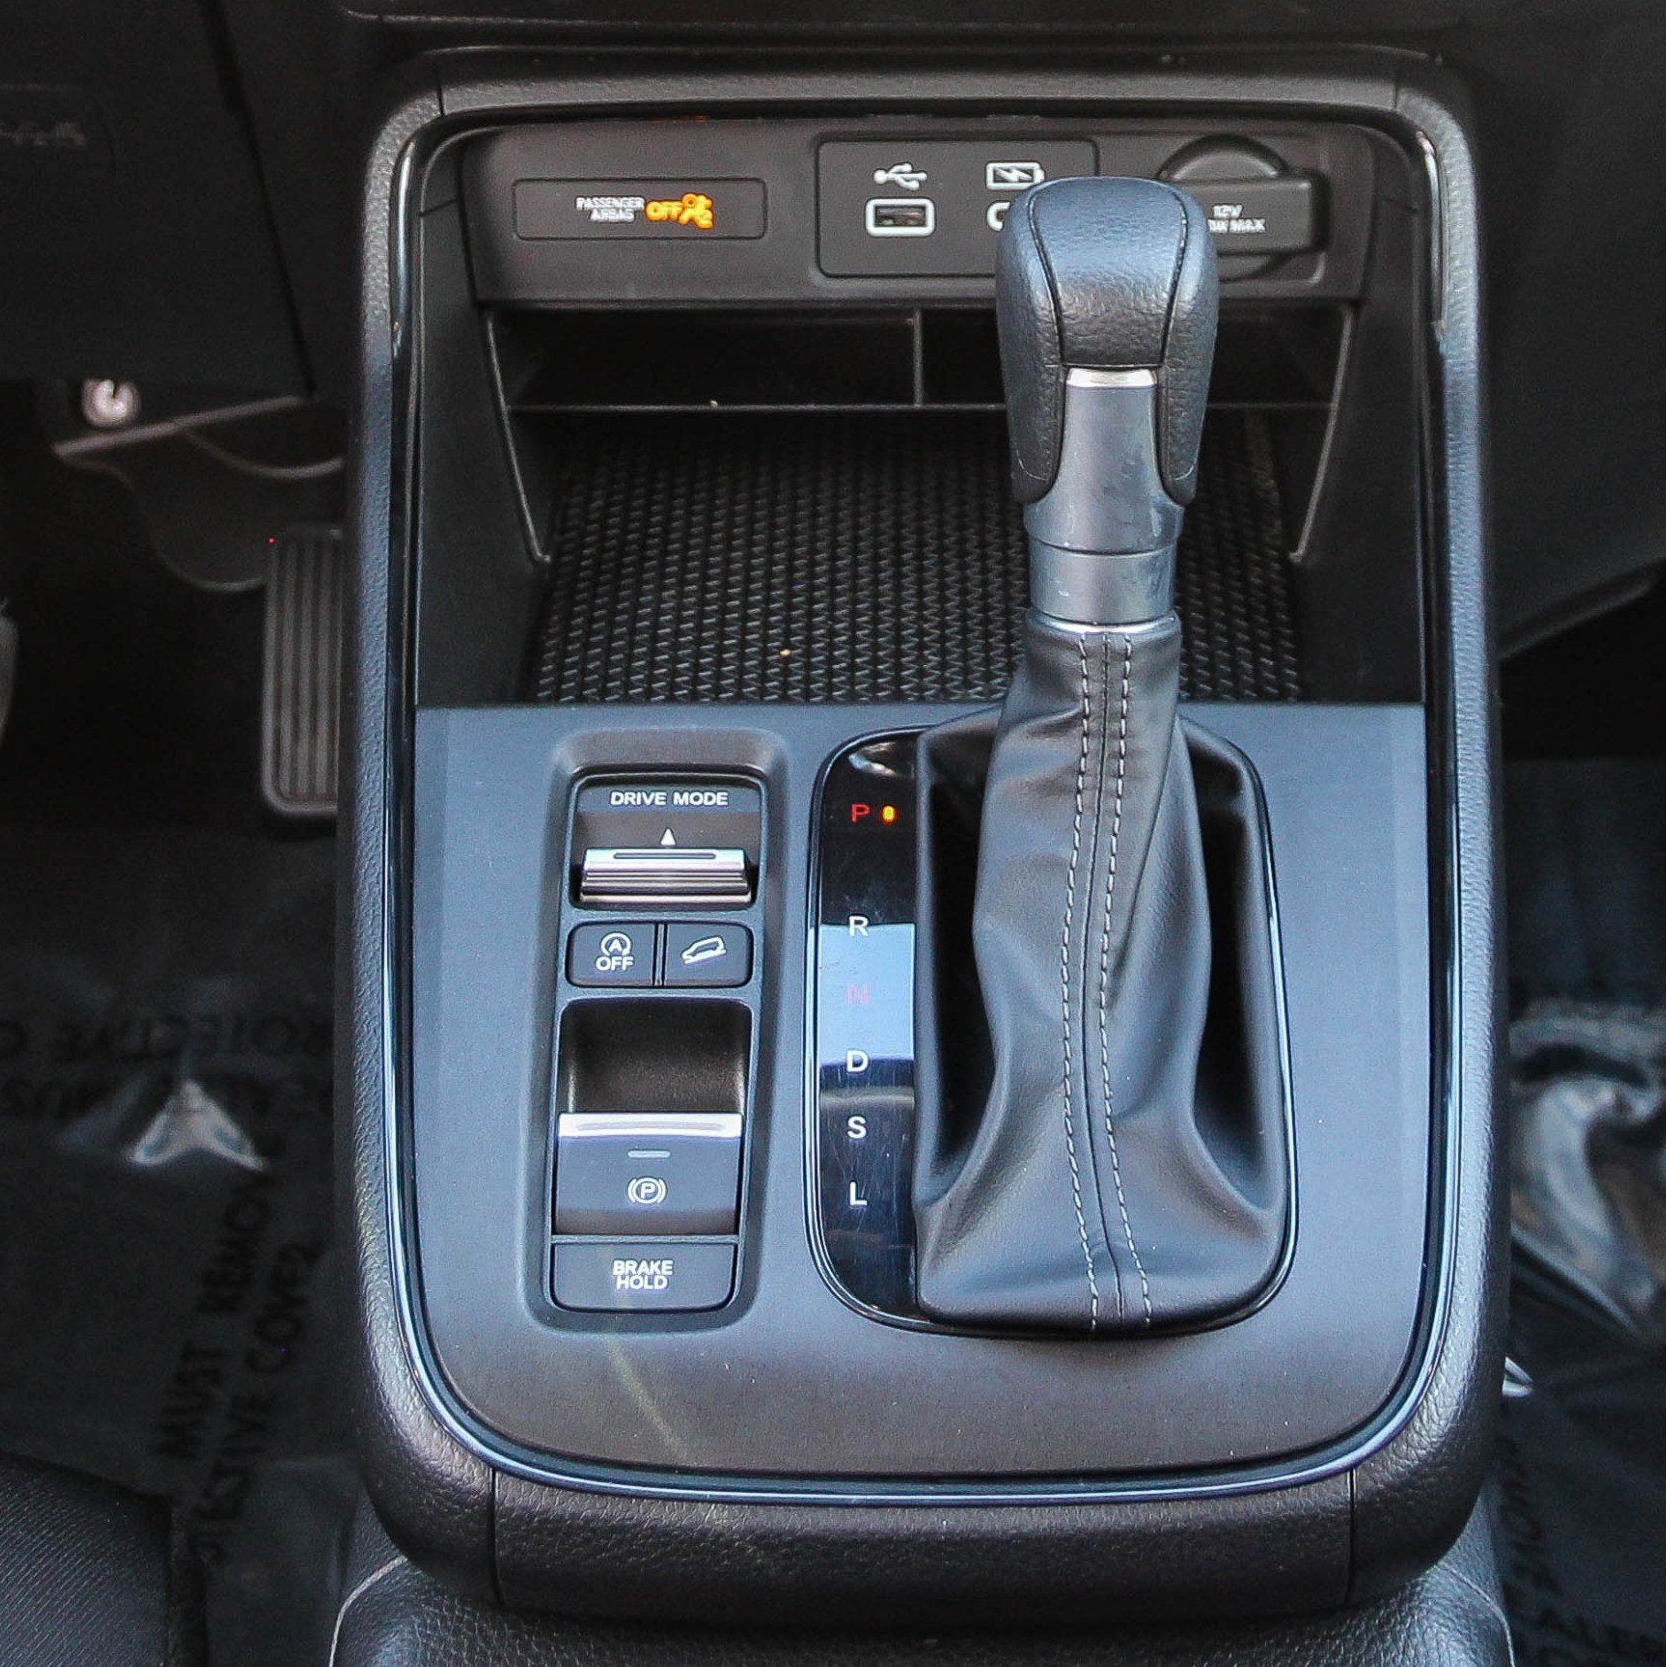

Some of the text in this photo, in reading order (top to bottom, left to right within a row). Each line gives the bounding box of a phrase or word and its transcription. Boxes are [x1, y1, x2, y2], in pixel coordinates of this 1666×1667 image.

[576, 196, 645, 210] PASSENGER
[645, 200, 683, 222] OFF
[610, 791, 728, 806] DRIVE MODE
[851, 804, 870, 822] P
[848, 916, 869, 936] R
[595, 956, 634, 971] OFF
[846, 1051, 868, 1072] D
[848, 1116, 867, 1138] S
[849, 1183, 867, 1205] L
[613, 1260, 673, 1276] BRAKE
[616, 1274, 668, 1289] HOLD
